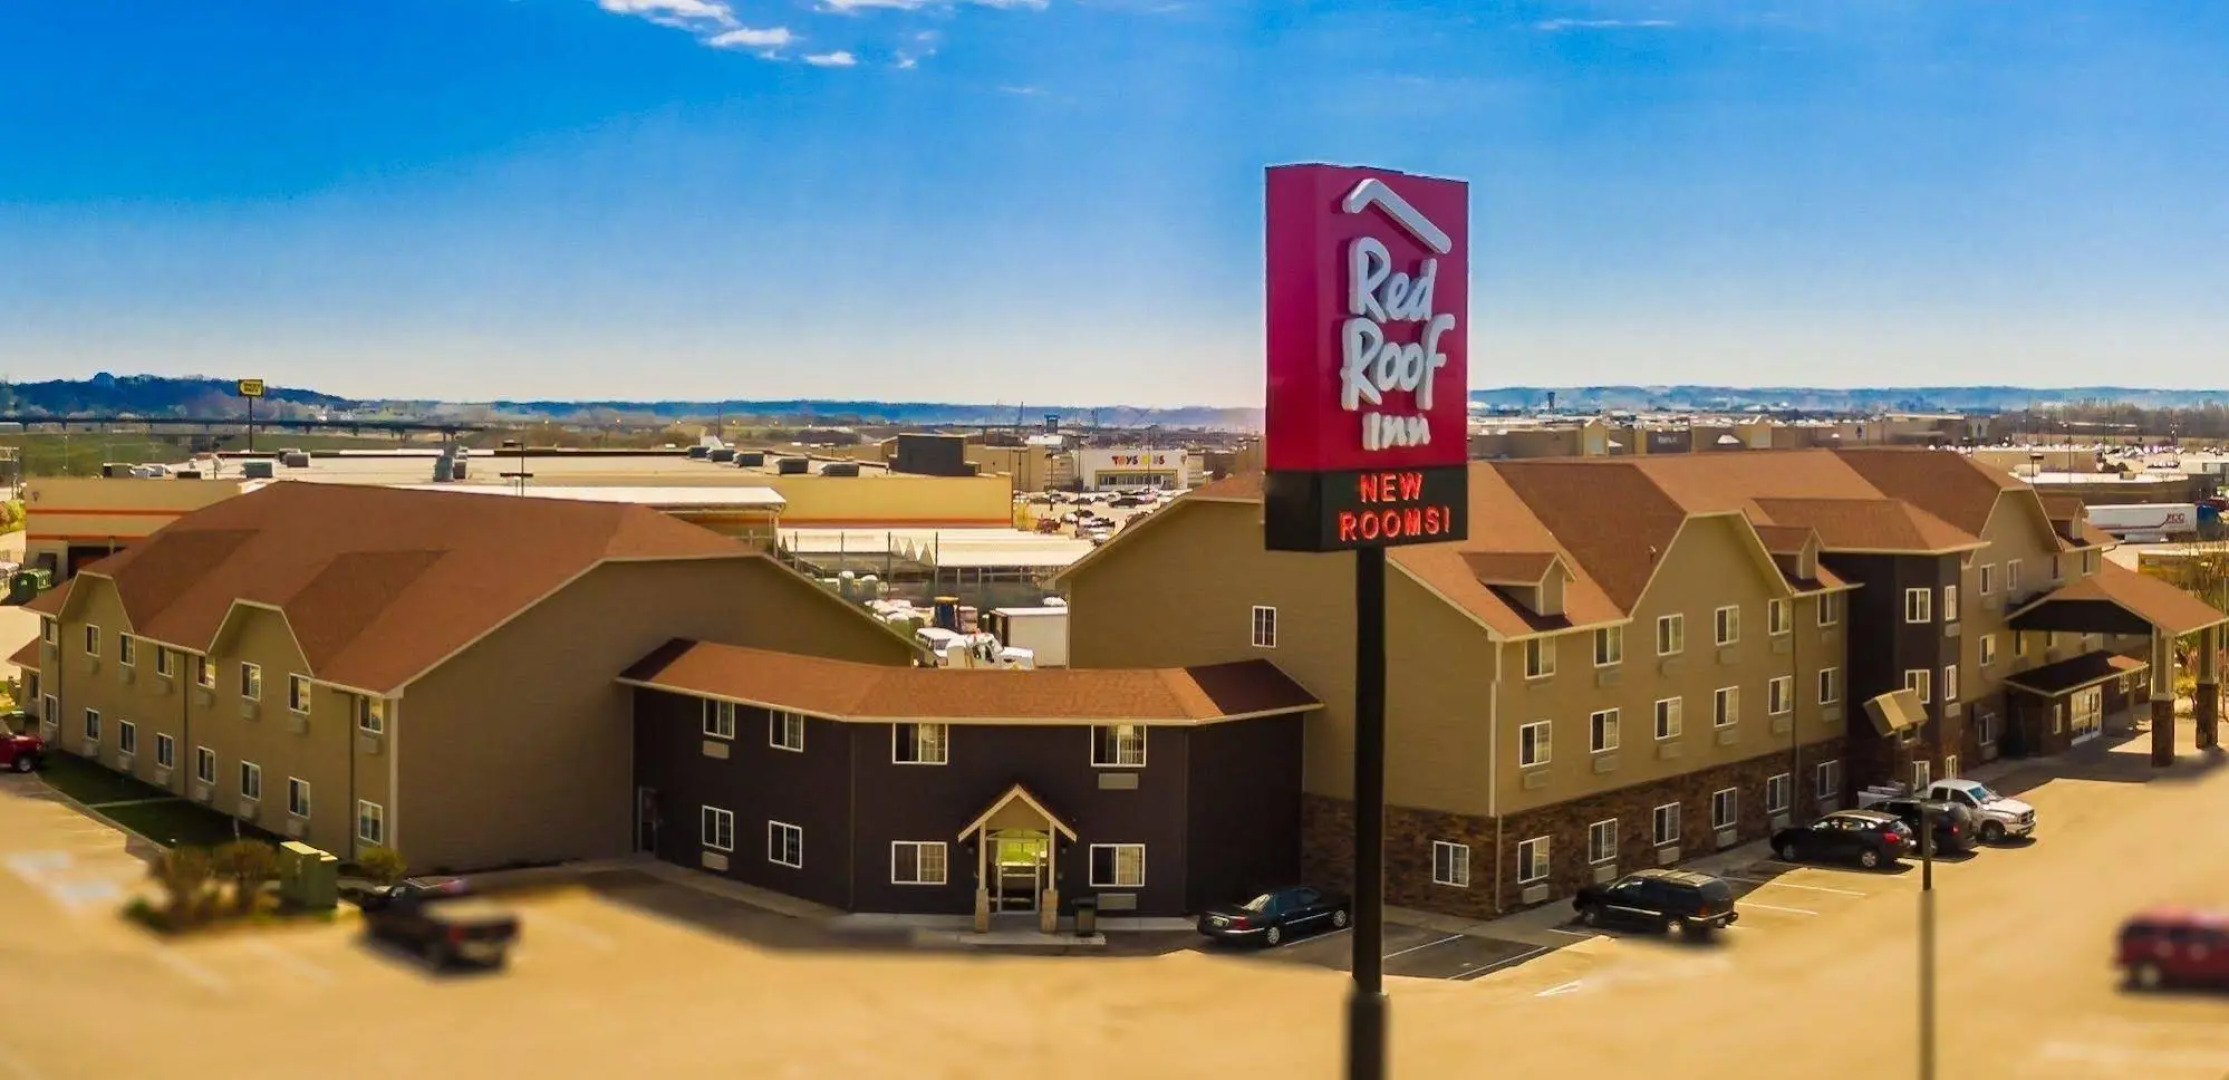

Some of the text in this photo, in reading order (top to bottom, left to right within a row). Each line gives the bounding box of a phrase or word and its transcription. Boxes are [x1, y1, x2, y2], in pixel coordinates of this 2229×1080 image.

[1349, 236, 1438, 323] Red
[1340, 313, 1456, 411] Roof
[1362, 411, 1431, 451] Inn
[1112, 455, 1139, 465] TOYS
[1360, 472, 1423, 503] NEW
[1338, 504, 1450, 542] ROOMS!
